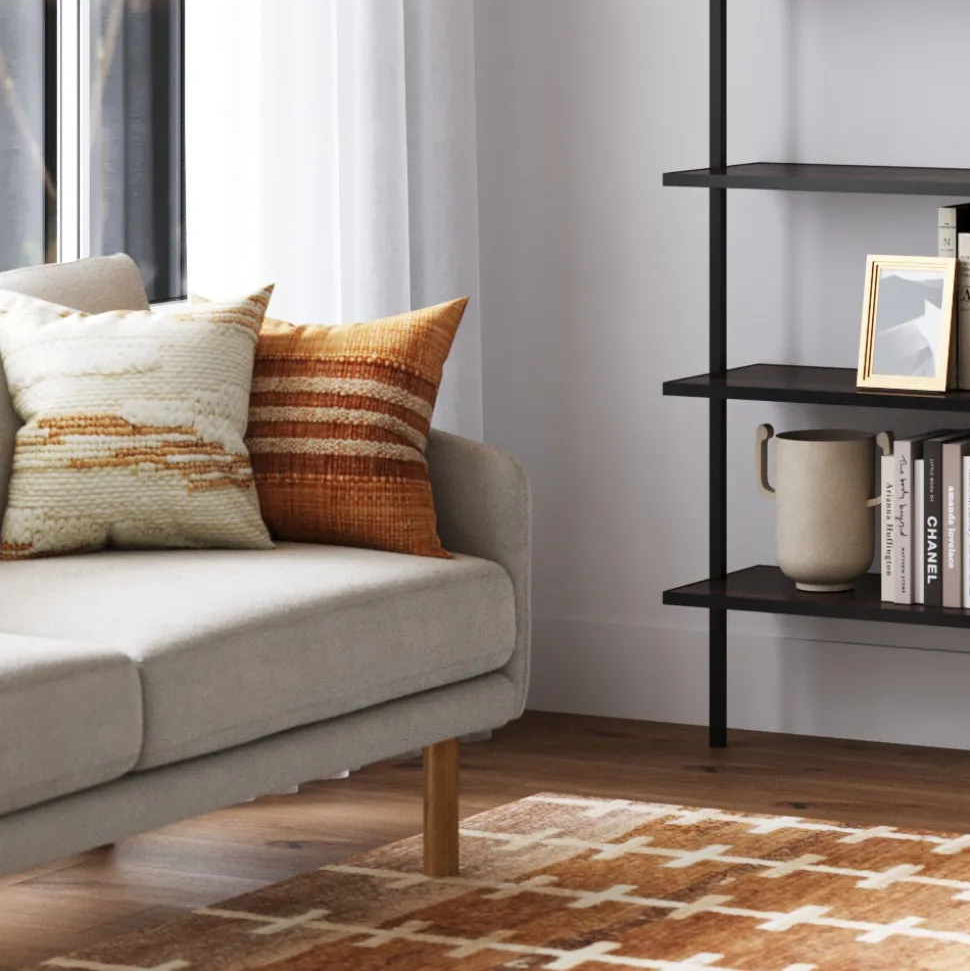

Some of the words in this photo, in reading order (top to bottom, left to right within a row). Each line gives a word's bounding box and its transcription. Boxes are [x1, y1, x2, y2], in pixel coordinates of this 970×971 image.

[899, 455, 908, 474] The
[899, 478, 909, 500] body
[929, 494, 934, 502] OF
[948, 486, 956, 526] amanda
[896, 504, 908, 536] beyond
[884, 524, 894, 576] Huffington
[927, 516, 938, 584] CHANEL
[948, 528, 956, 570] lovelace
